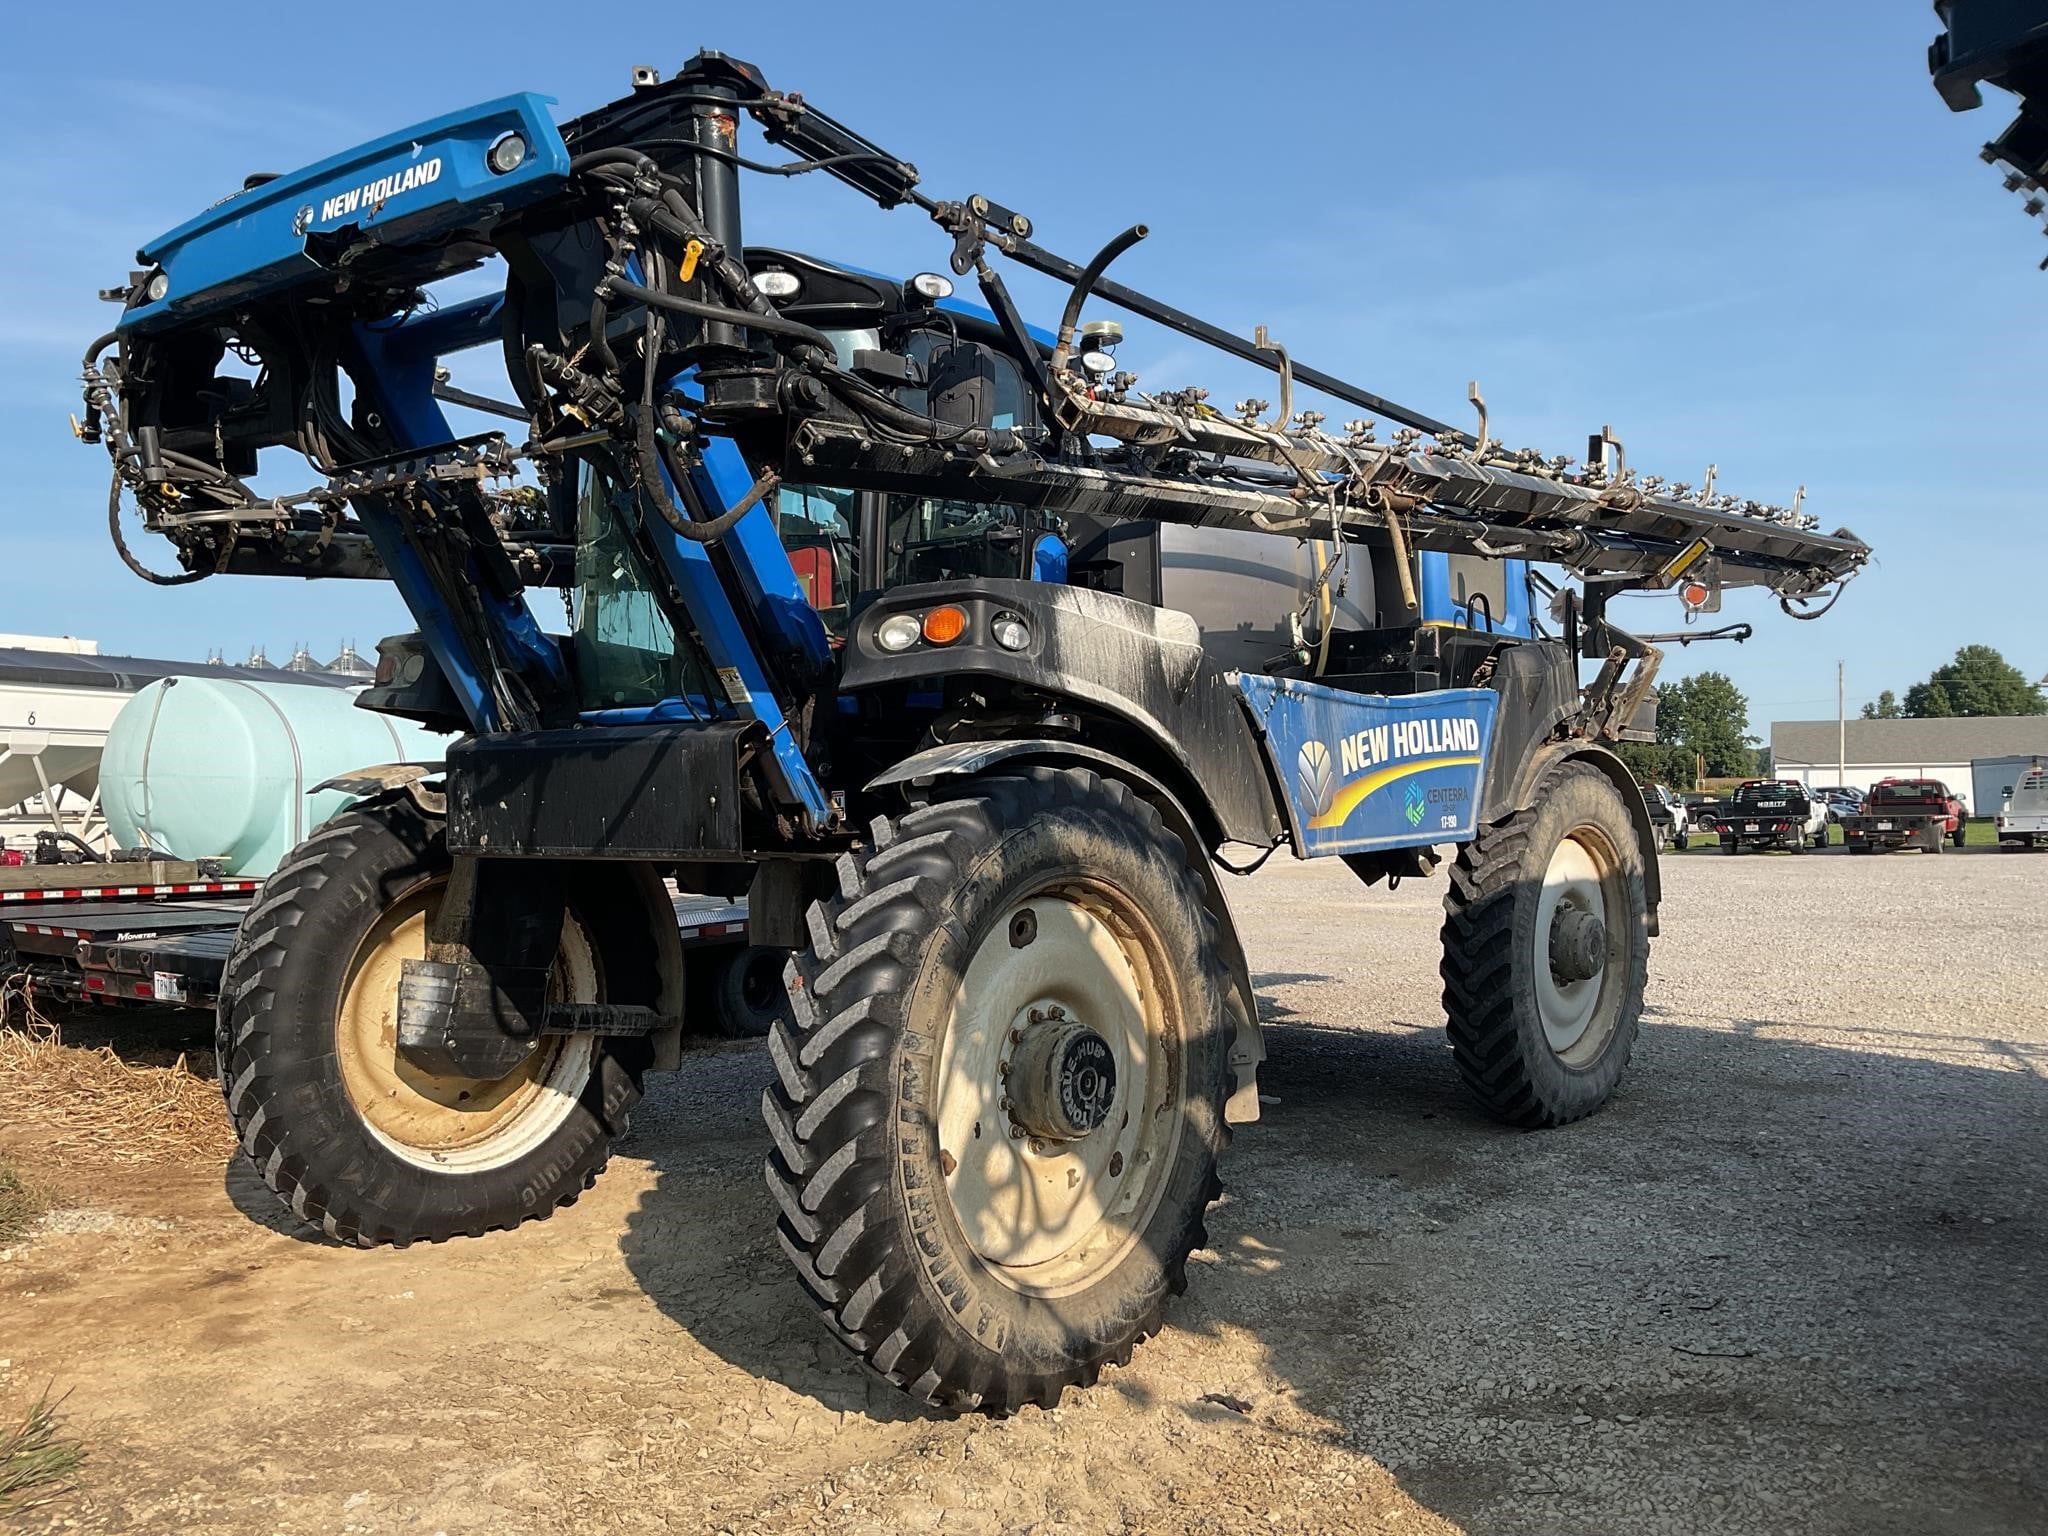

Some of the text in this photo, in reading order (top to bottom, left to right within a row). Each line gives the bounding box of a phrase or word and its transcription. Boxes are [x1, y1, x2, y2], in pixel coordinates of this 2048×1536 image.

[321, 158, 441, 222] NEW HOLLAND
[28, 711, 36, 726] 6
[1340, 718, 1479, 776] NEW HOLLAND
[1427, 787, 1469, 804] CENTERRA
[521, 1084, 631, 1208] TRLLEBORG
